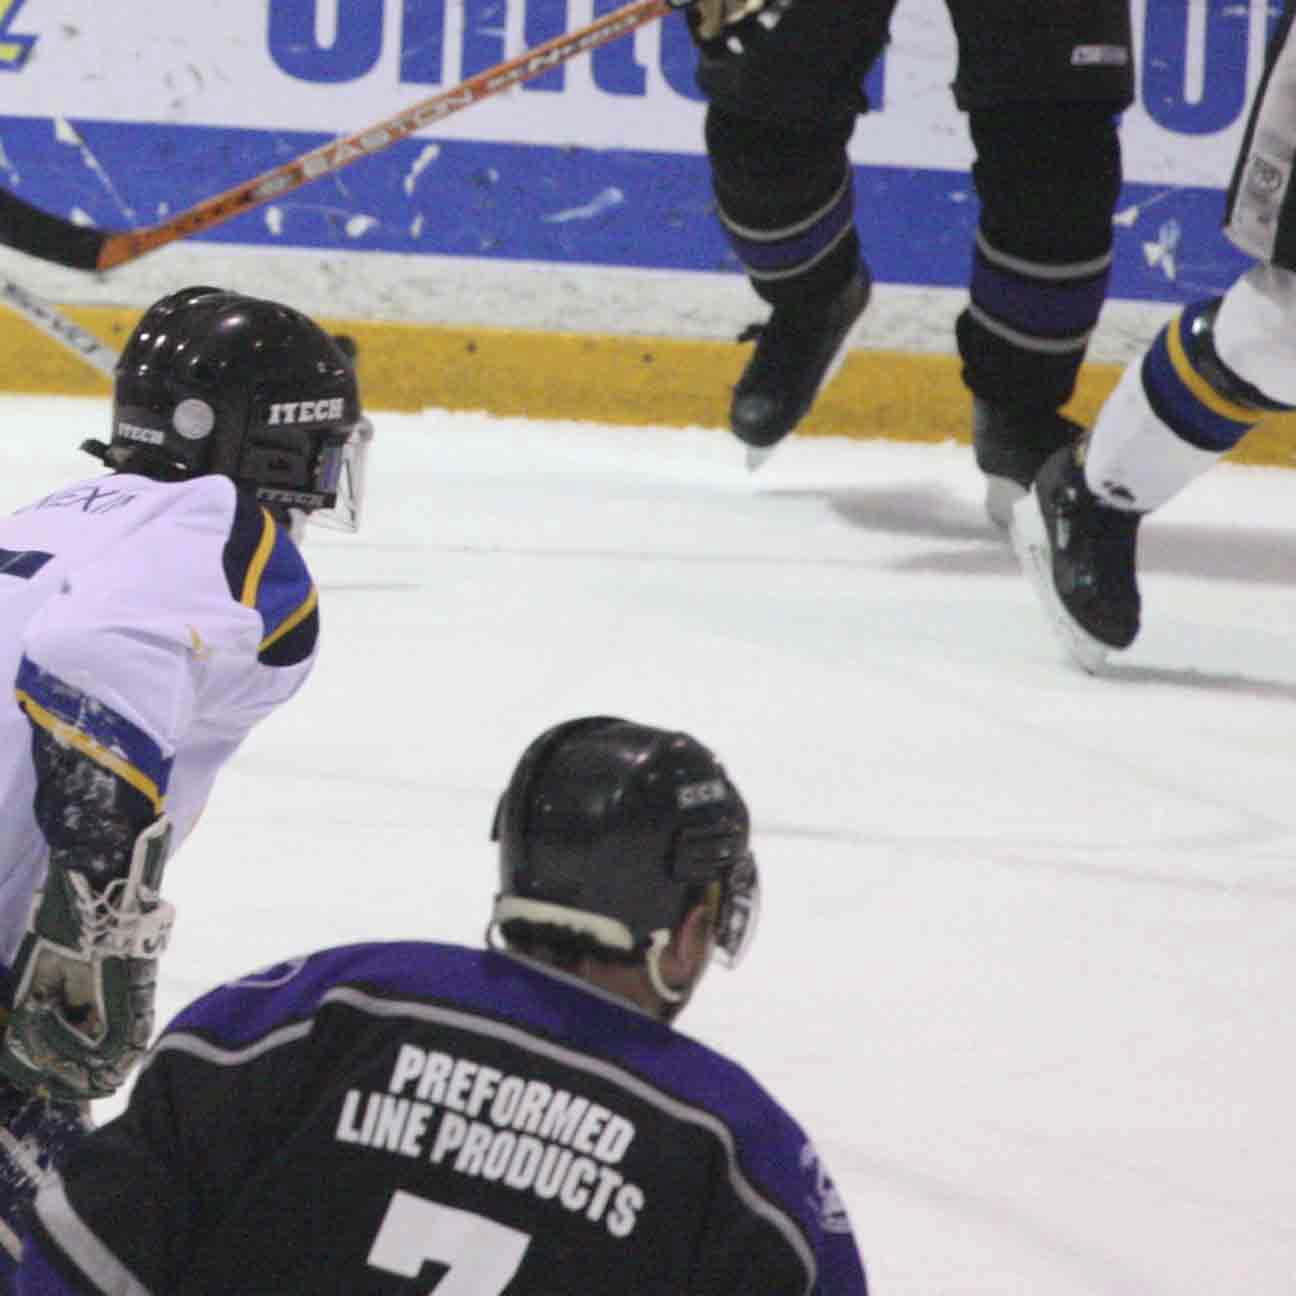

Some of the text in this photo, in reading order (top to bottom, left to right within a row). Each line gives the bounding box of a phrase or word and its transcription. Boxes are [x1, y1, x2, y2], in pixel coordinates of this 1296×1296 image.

[118, 422, 166, 446] ITECH
[267, 397, 345, 426] ITECH
[389, 1042, 636, 1164] PREFORMED
[335, 1088, 645, 1238] LINE PRODUCTS
[366, 1188, 533, 1296] 7
